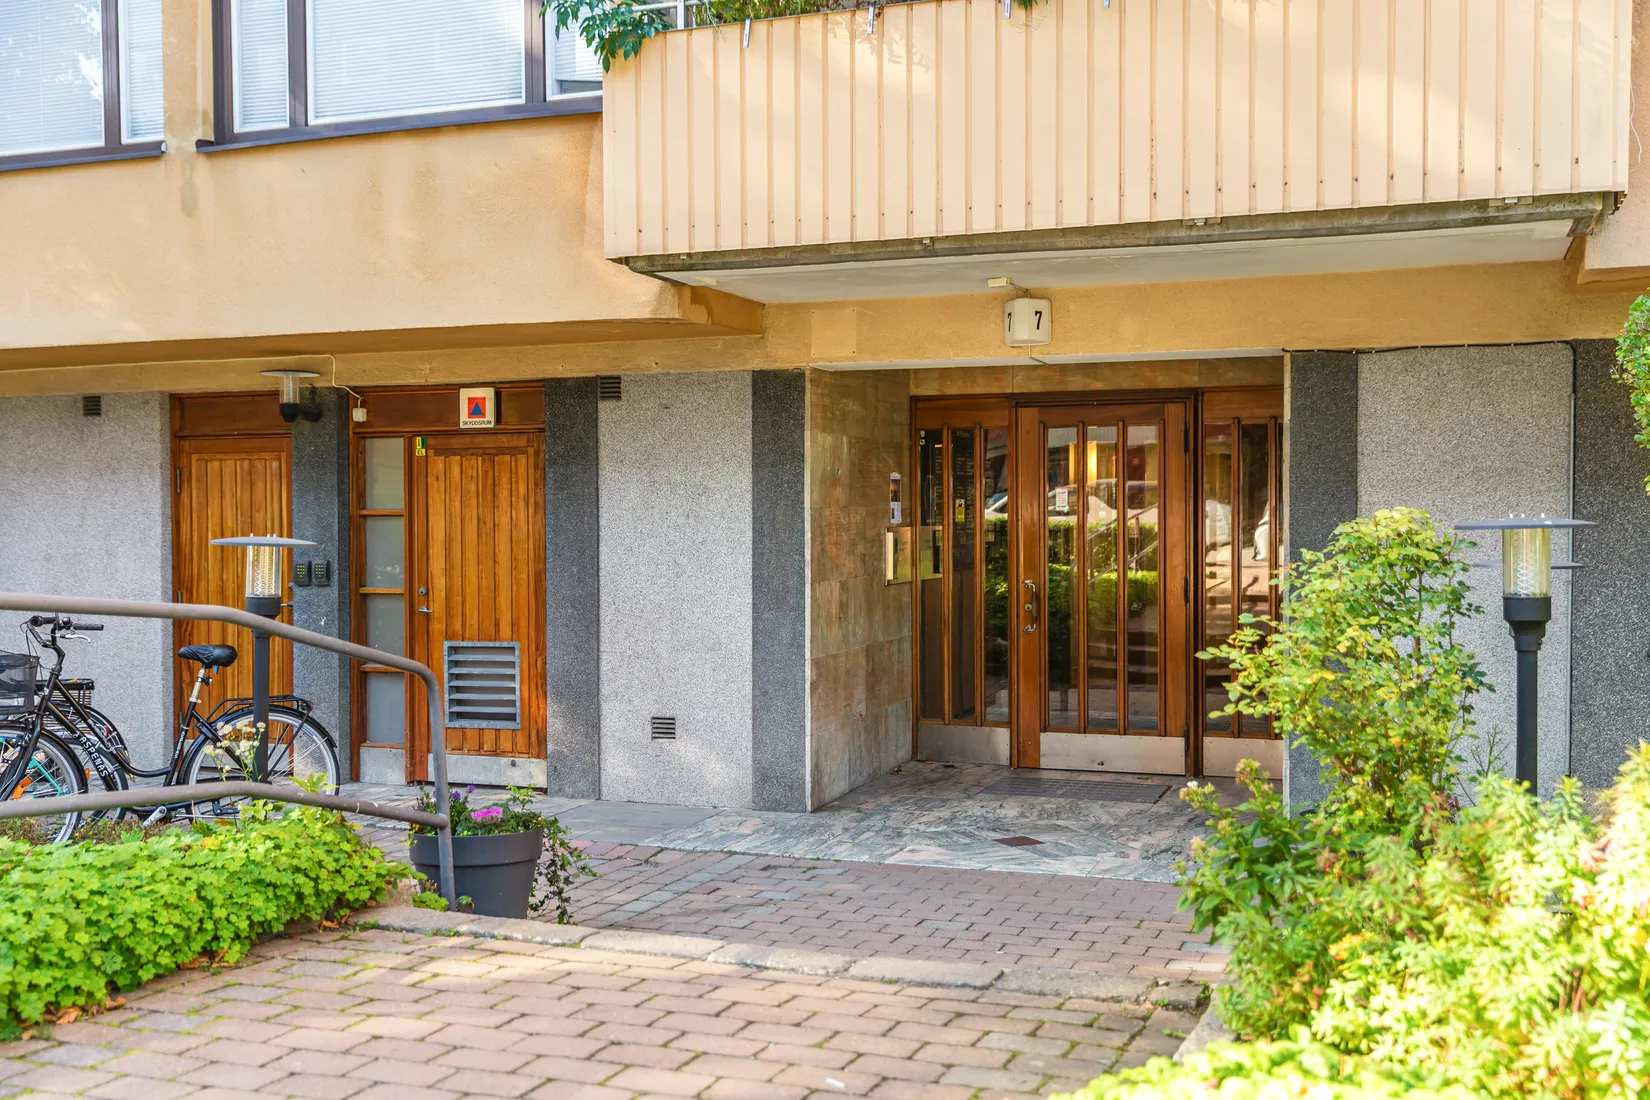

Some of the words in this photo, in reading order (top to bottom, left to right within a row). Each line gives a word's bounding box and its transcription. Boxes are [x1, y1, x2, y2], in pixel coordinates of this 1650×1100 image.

[1007, 312, 1012, 332] 7
[1034, 310, 1043, 330] 7
[462, 419, 492, 427] SKYDDSRUM
